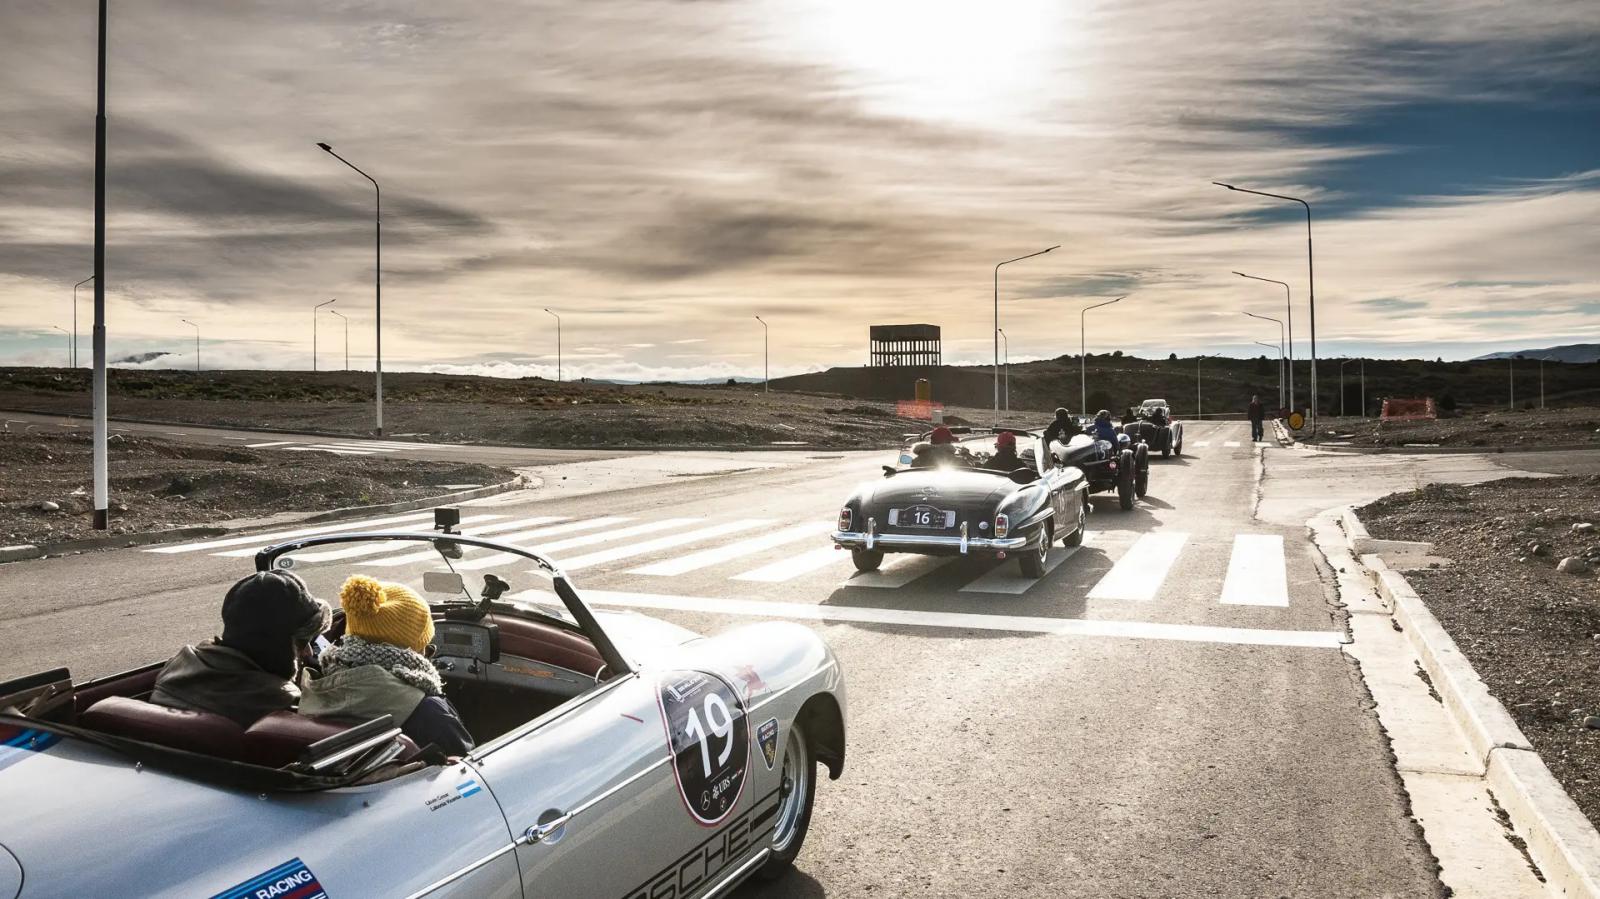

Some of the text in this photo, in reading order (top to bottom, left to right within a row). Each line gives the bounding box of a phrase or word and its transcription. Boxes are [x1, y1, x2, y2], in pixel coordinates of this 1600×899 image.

[914, 511, 930, 525] 16
[685, 692, 734, 778] 19
[255, 870, 313, 899] RACING
